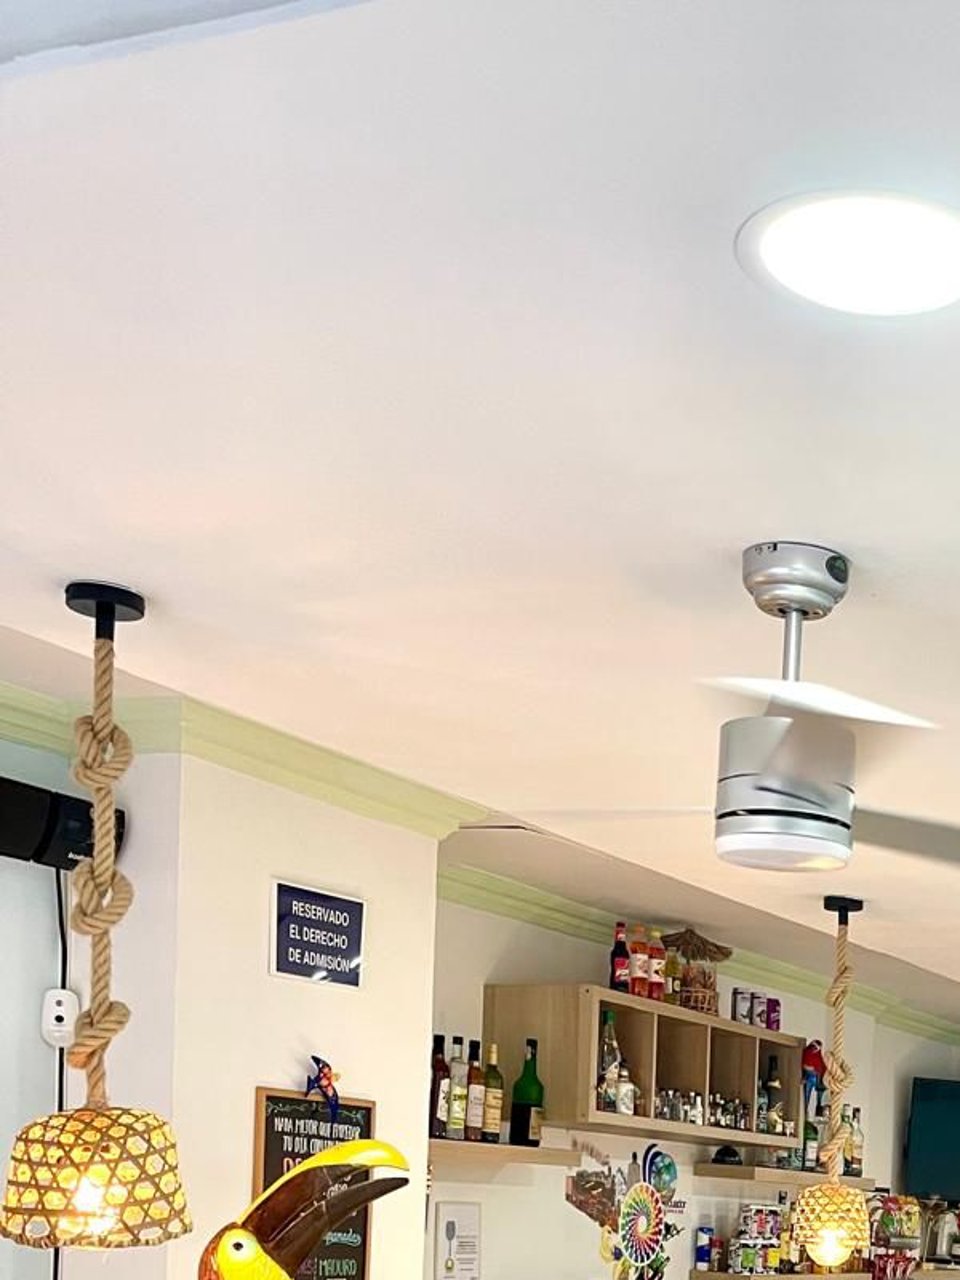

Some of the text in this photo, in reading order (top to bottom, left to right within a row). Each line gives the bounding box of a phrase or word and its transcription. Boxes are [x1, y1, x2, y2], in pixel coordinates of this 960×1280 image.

[292, 901, 349, 926] RESERVADO
[290, 924, 347, 949] EL DERECHO
[288, 947, 350, 972] DE ADMISIÓN
